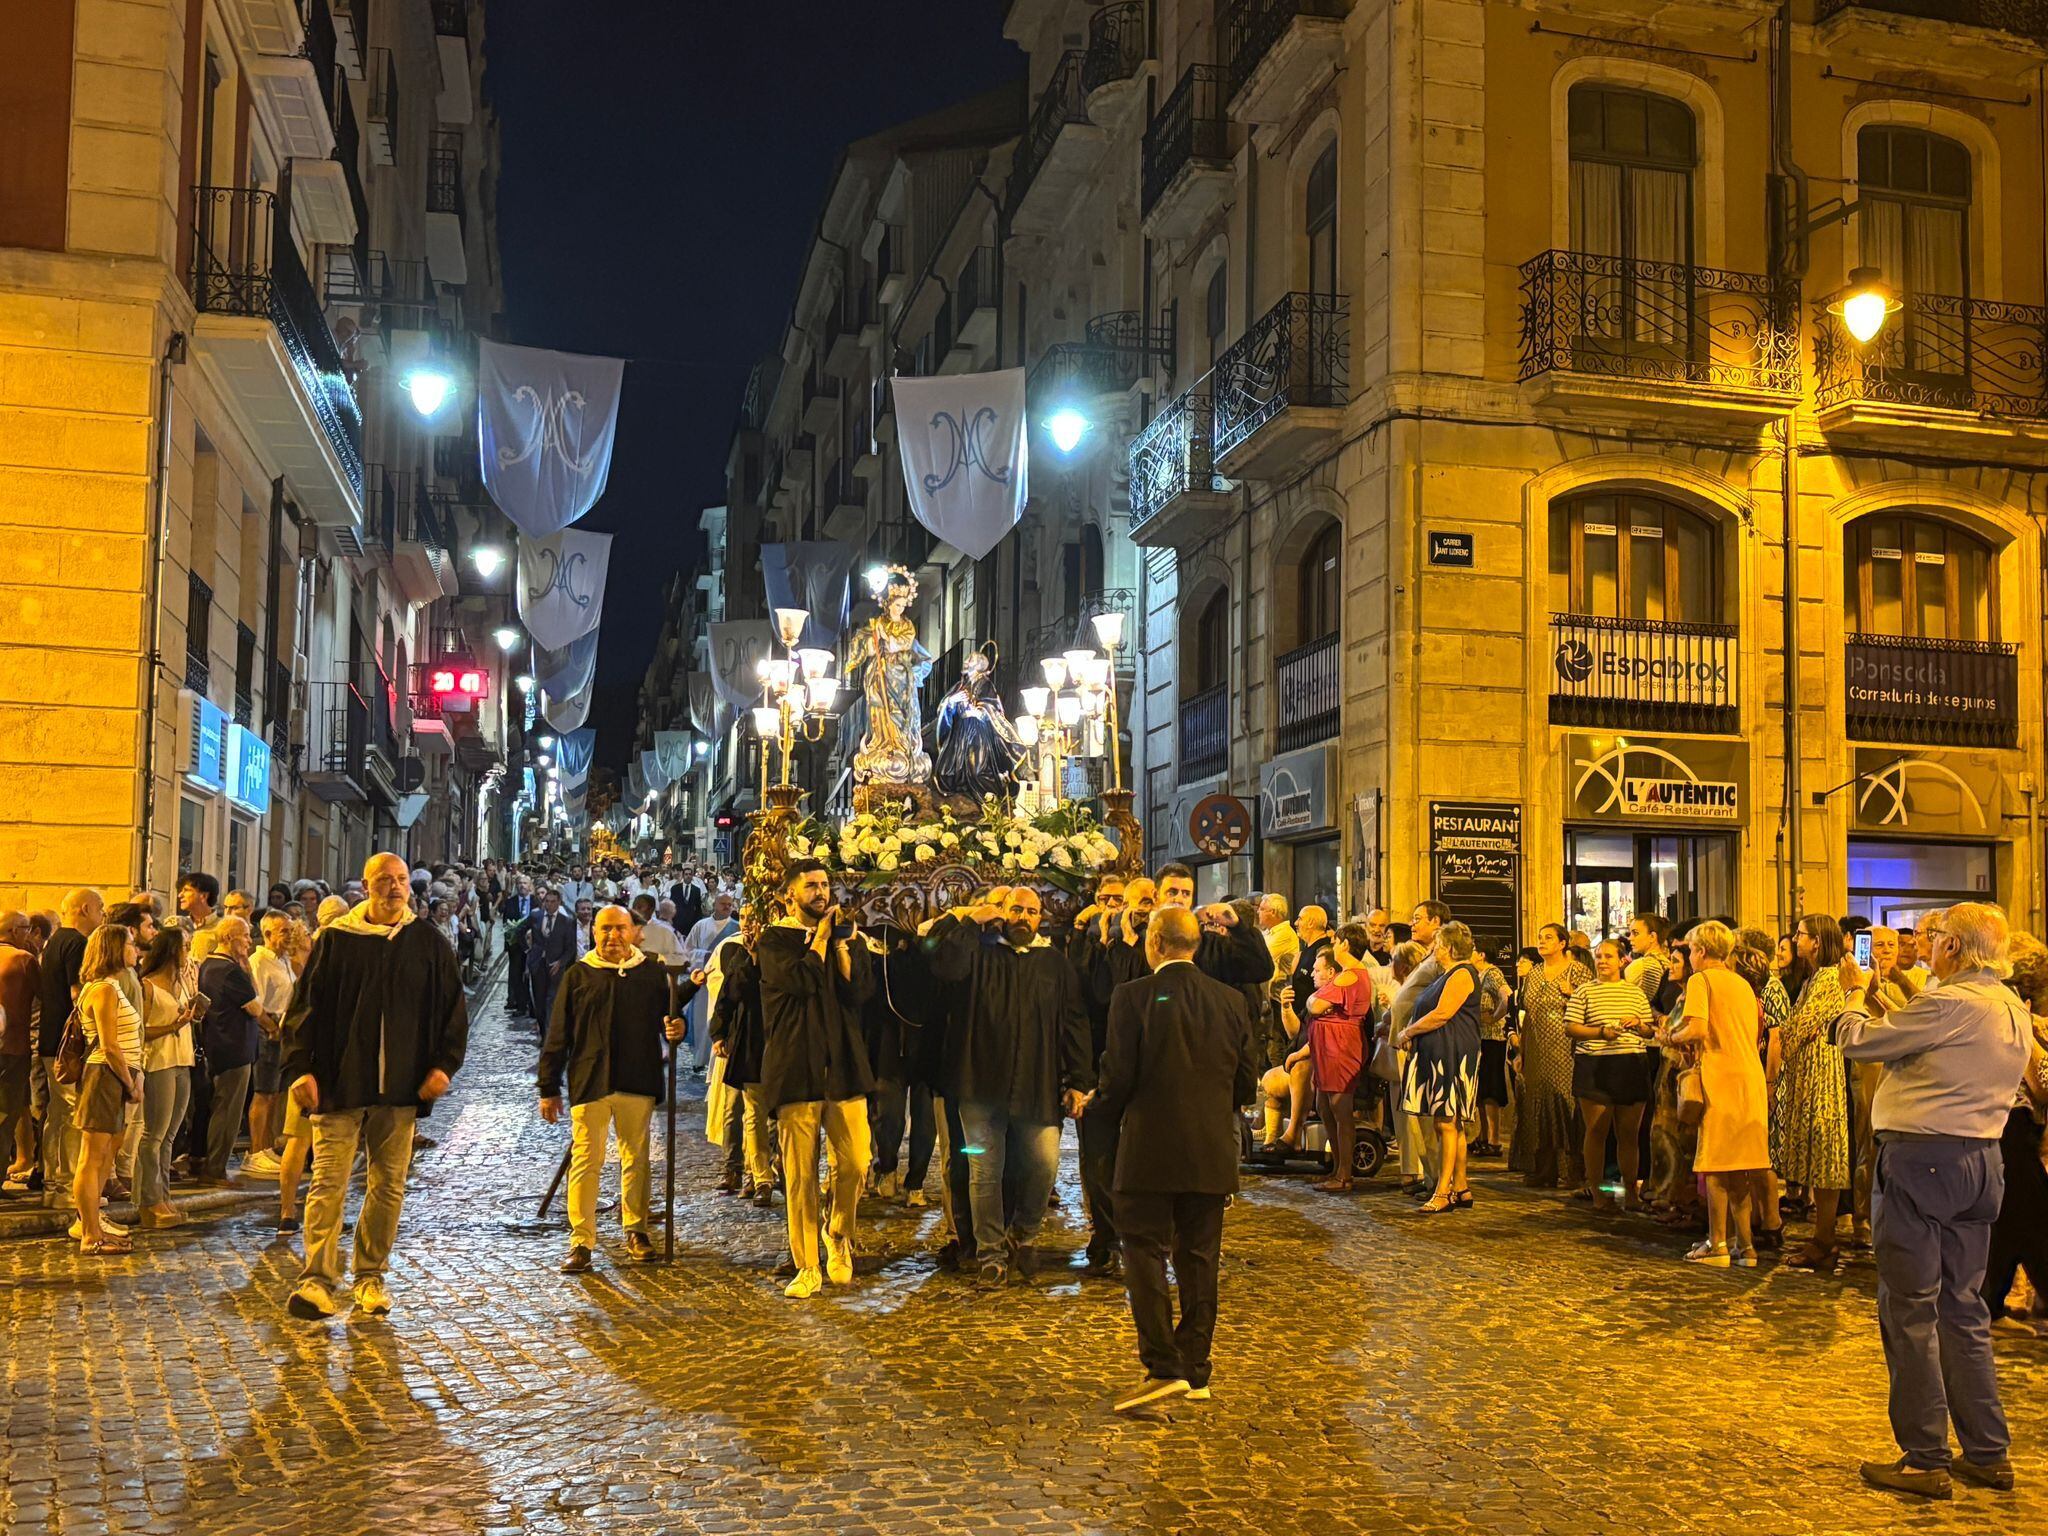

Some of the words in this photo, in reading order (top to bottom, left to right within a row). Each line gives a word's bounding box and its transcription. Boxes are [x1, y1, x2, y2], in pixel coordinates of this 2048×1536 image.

[1442, 538, 1462, 547] CARRER
[1602, 651, 1727, 683] Espabrok
[1944, 695, 1997, 711] seguros
[1628, 803, 1734, 817] Café-Restaurant
[1434, 816, 1520, 833] RESTAURANT
[1475, 854, 1509, 867] Diario
